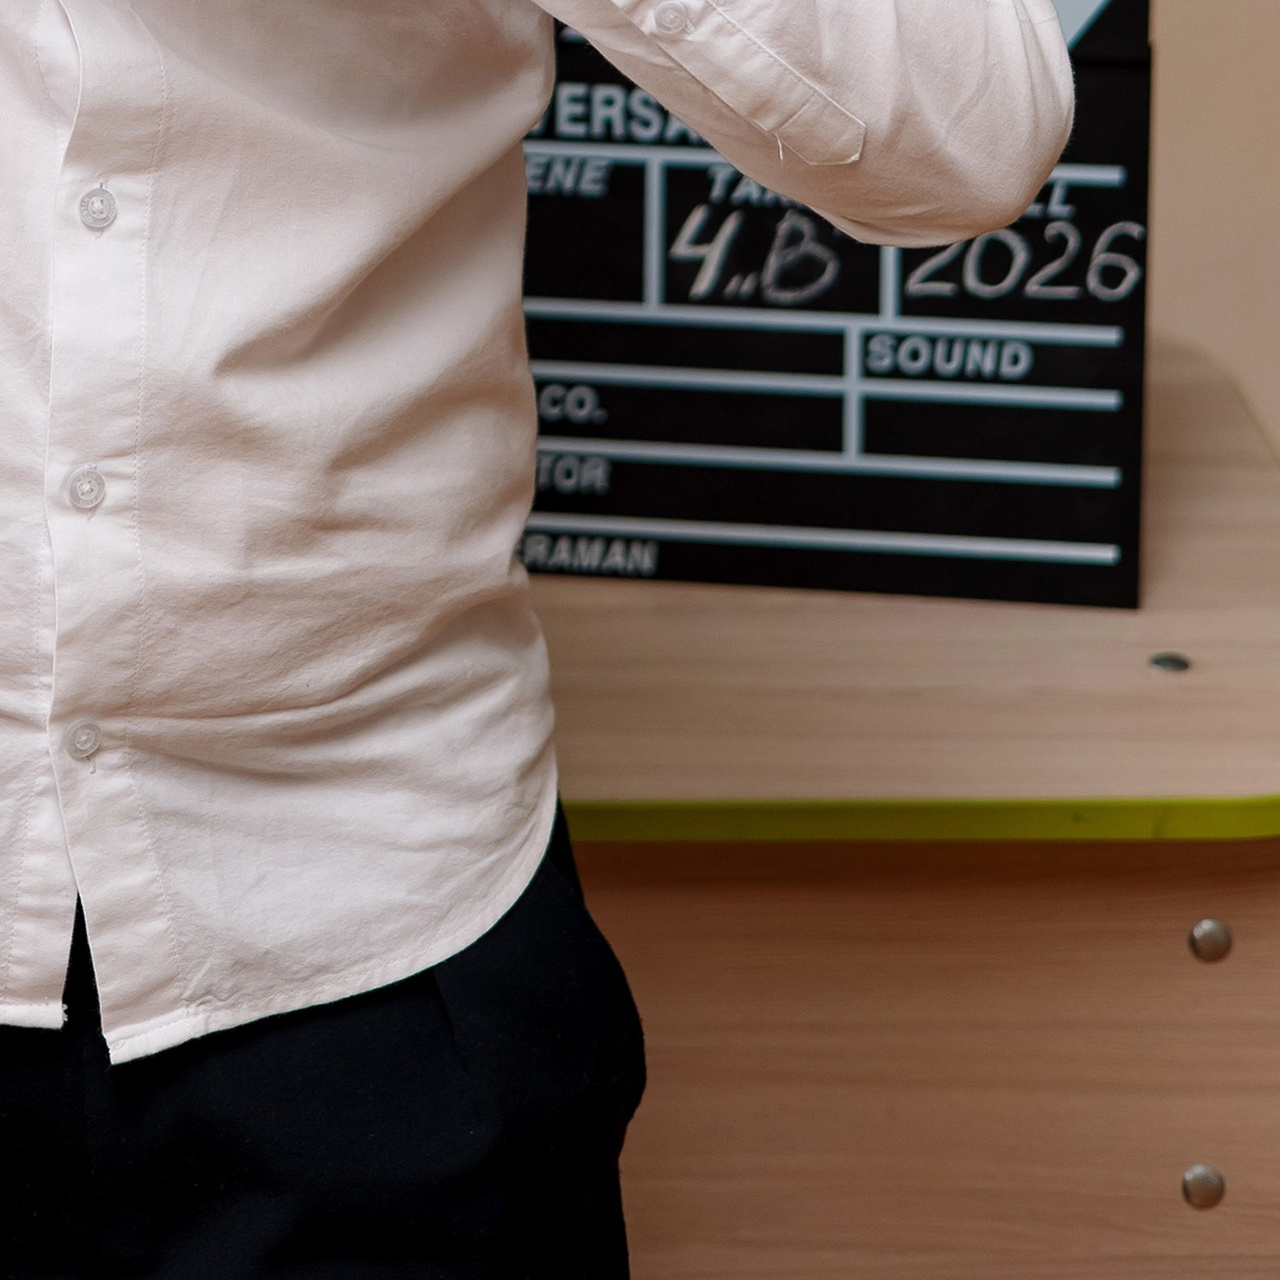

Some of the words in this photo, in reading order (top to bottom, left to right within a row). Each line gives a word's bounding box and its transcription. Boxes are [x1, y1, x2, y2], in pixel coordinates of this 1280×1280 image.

[526, 157, 609, 197] ENE
[904, 220, 1146, 303] 2026
[866, 334, 1034, 378] SOUND
[537, 453, 610, 493] TOR
[516, 533, 658, 575] RAMAN
